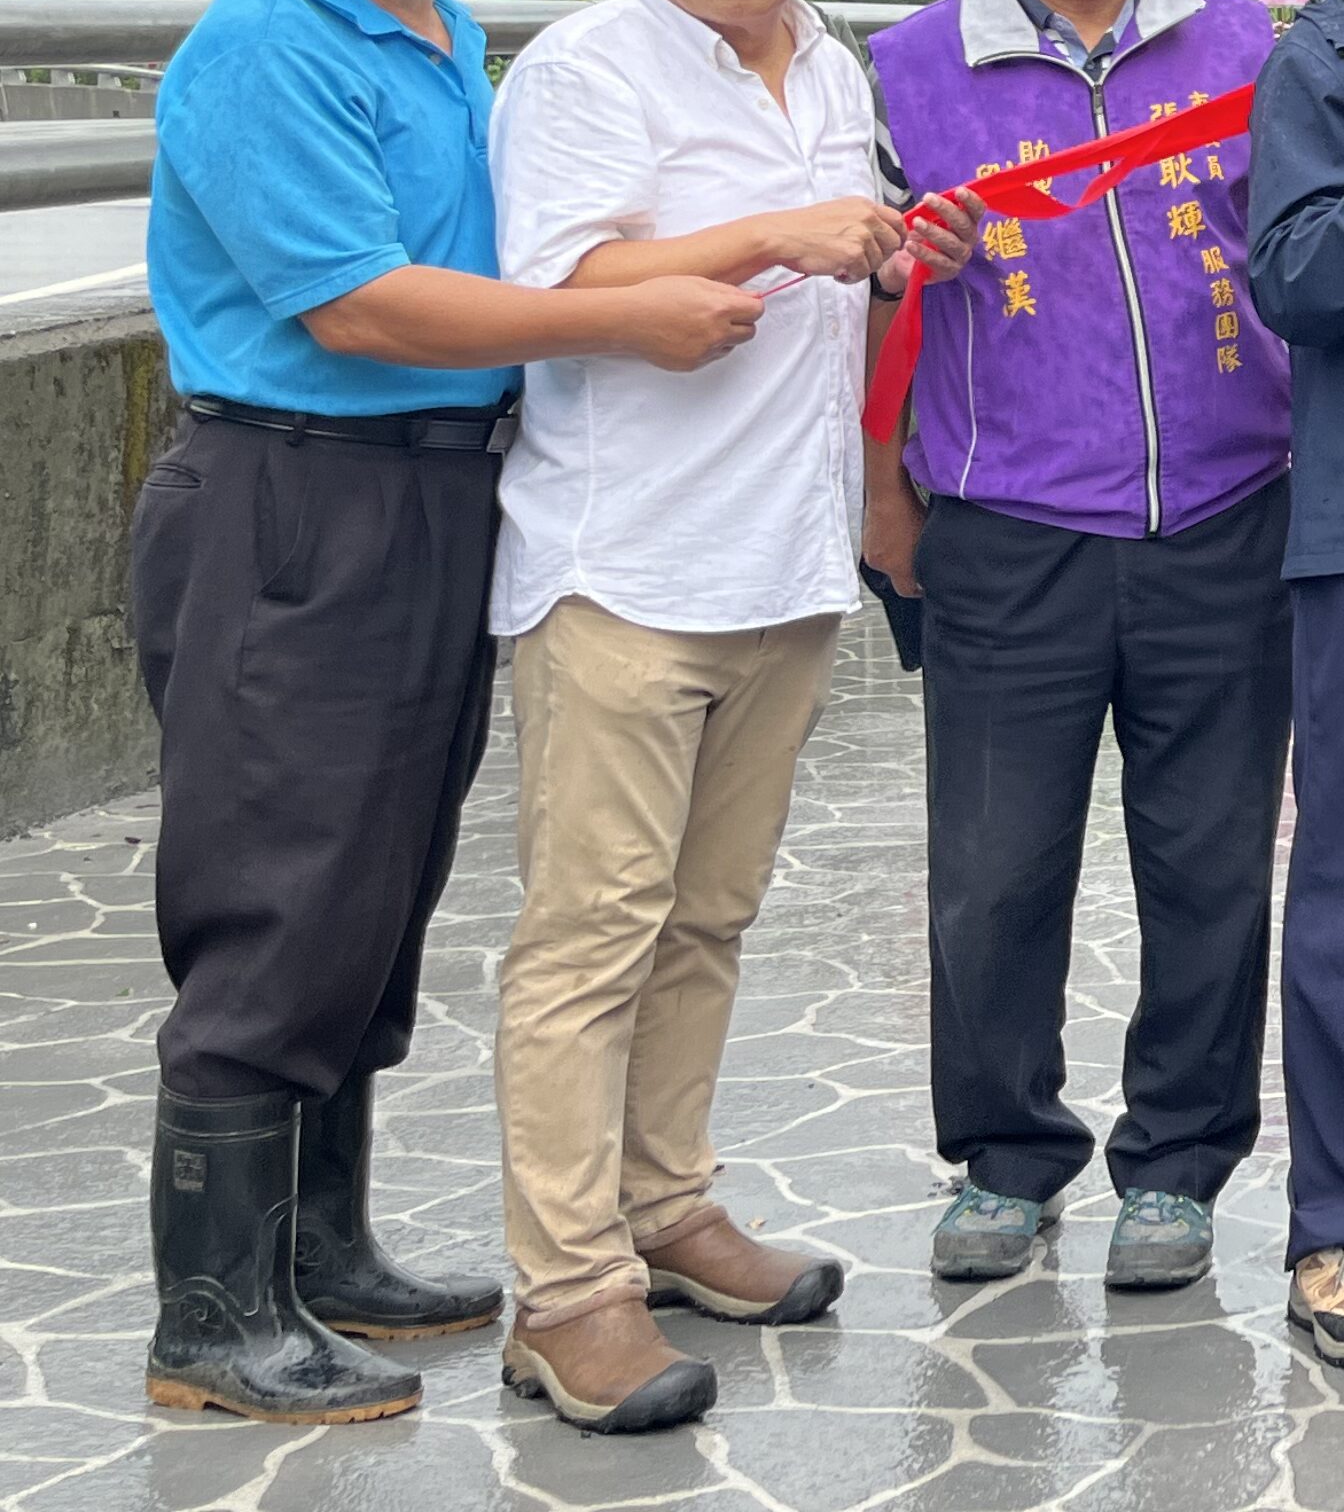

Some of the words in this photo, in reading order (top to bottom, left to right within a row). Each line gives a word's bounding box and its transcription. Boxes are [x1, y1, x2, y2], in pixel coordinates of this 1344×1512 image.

[975, 162, 1036, 318] 繼漢
[1200, 245, 1243, 374] 服務團隊
